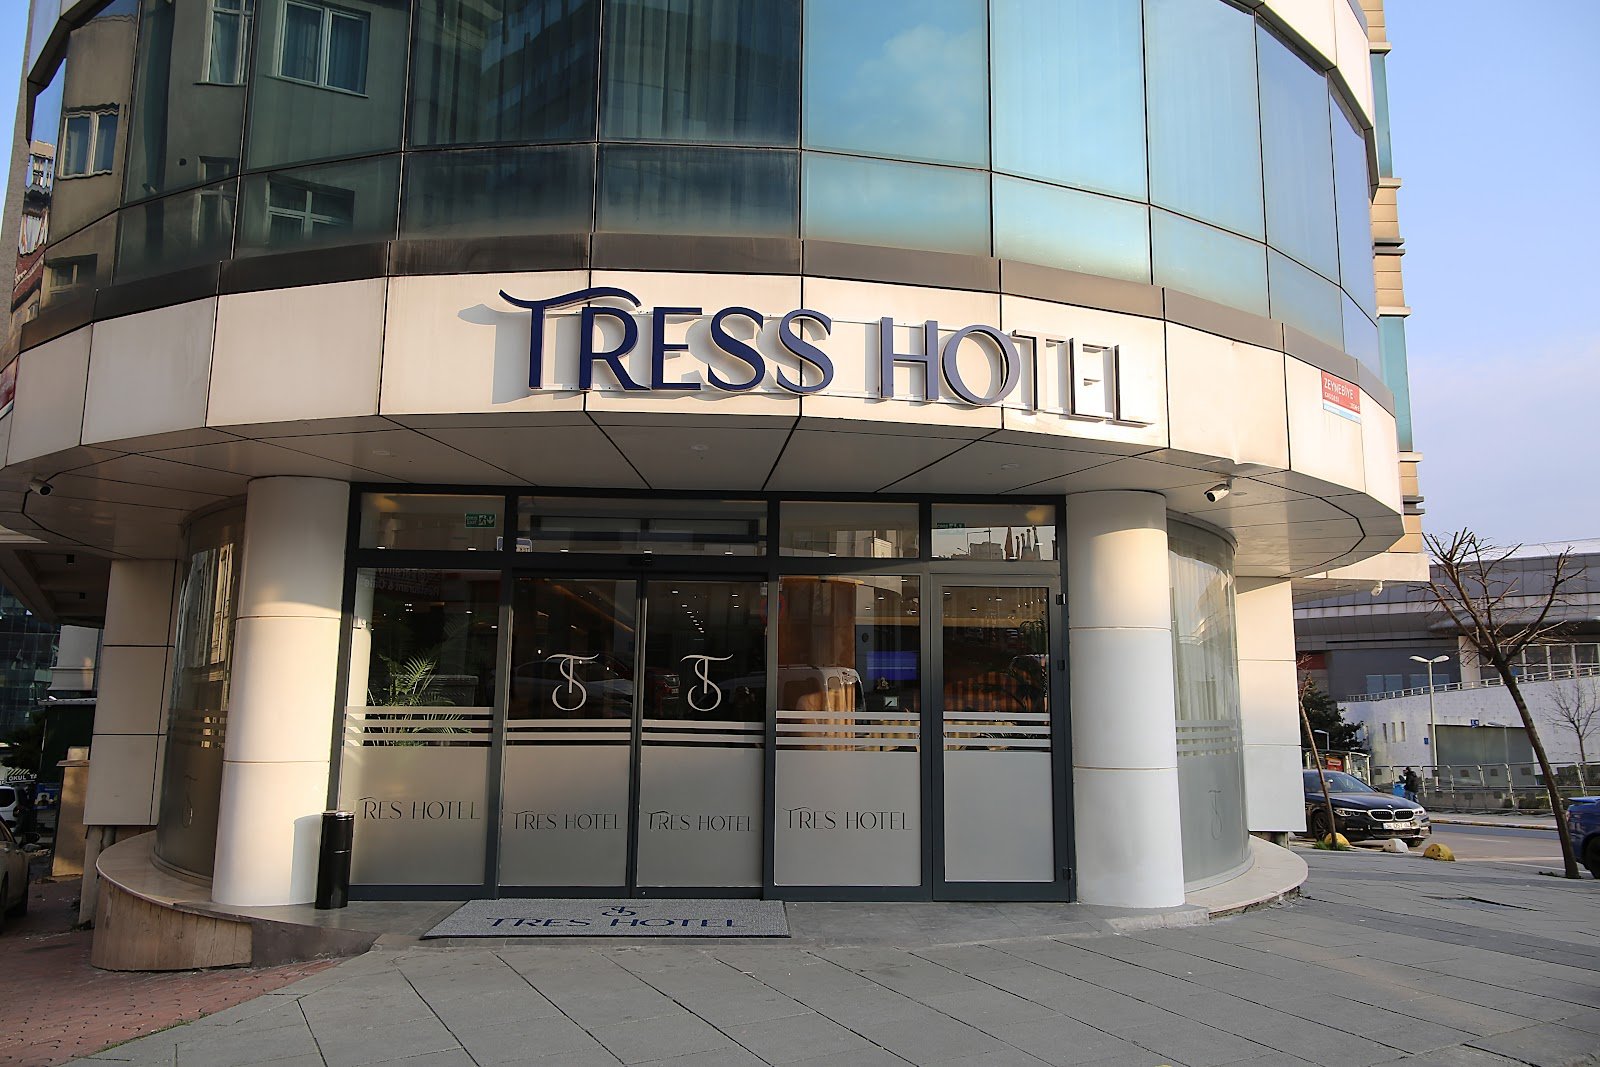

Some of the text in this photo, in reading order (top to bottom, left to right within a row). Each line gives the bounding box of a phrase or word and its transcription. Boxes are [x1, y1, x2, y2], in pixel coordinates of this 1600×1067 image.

[499, 286, 1154, 427] TRESS HOTEL
[412, 800, 480, 820] HOTEL
[512, 810, 622, 830] TRES HOTEL
[782, 806, 912, 831] TRES HOTEL
[645, 810, 756, 832] TRES HOTEL
[486, 917, 747, 929] TRES HOTEL
